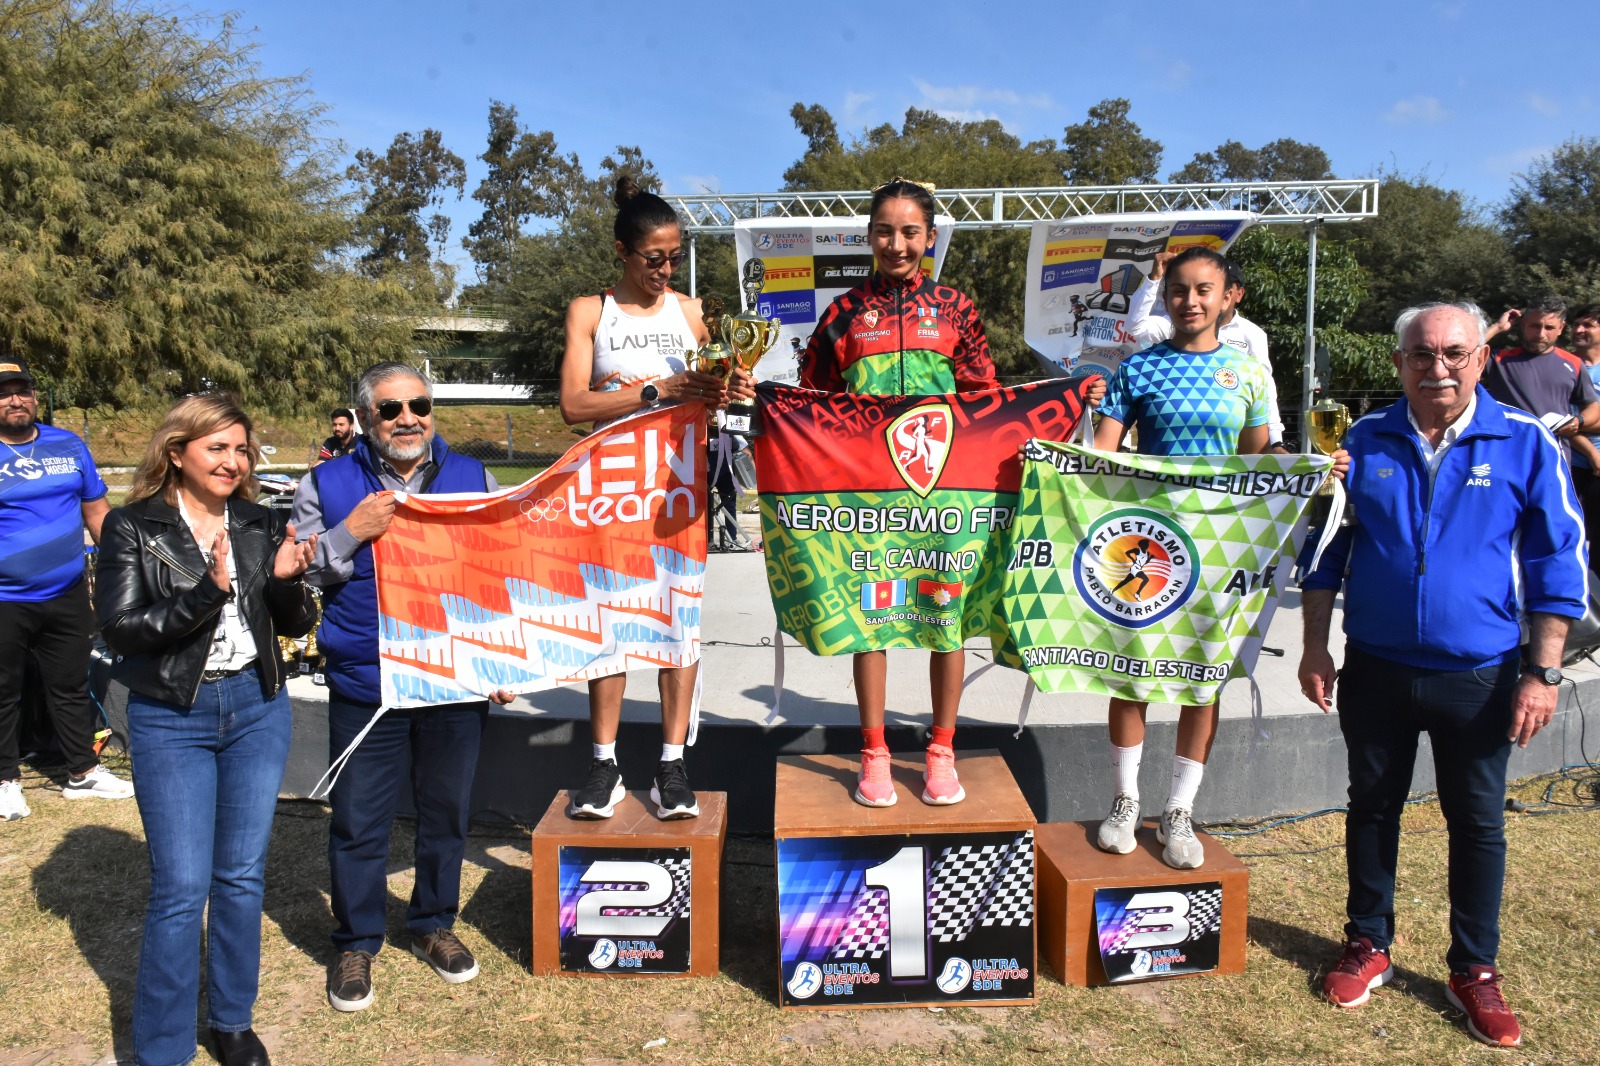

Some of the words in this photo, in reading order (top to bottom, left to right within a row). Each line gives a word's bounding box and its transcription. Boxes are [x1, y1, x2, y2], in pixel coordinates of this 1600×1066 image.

[842, 269, 870, 277] VALLE
[776, 301, 811, 309] SANTIAGO
[854, 329, 891, 339] AEROBISMO
[917, 329, 940, 337] FRIAS
[1466, 478, 1491, 487] ARG
[568, 485, 696, 527] team
[777, 501, 963, 534] AEROBISMO
[1092, 521, 1186, 567] ATLETISMO
[851, 550, 880, 572] EL
[885, 548, 976, 572] CAMINO
[1085, 566, 1112, 605] PABLO
[1114, 579, 1184, 617] BARRAGAN
[865, 612, 905, 626] SANTIAGO
[906, 612, 924, 623] DEL
[925, 615, 956, 627] ESTERO
[1023, 646, 1110, 670] SANTIAGO
[1112, 655, 1151, 677] DEL
[1154, 659, 1230, 683] ESTERO
[576, 860, 674, 937] 2
[866, 846, 927, 977] 1
[1122, 891, 1191, 950] 3
[617, 940, 657, 951] ULTRA
[618, 949, 664, 959] EVENTOS
[1151, 949, 1181, 958] ULTRA
[1152, 954, 1187, 965] EVENTOS
[617, 958, 643, 968] SDE
[822, 962, 871, 975] ULTRA
[972, 957, 1020, 970] ULTRA
[1152, 963, 1171, 972] SDE
[823, 972, 880, 985] EVENTOS
[972, 968, 1029, 981] EVENTOS
[823, 984, 854, 996] SDE
[973, 979, 1003, 991] SDE
